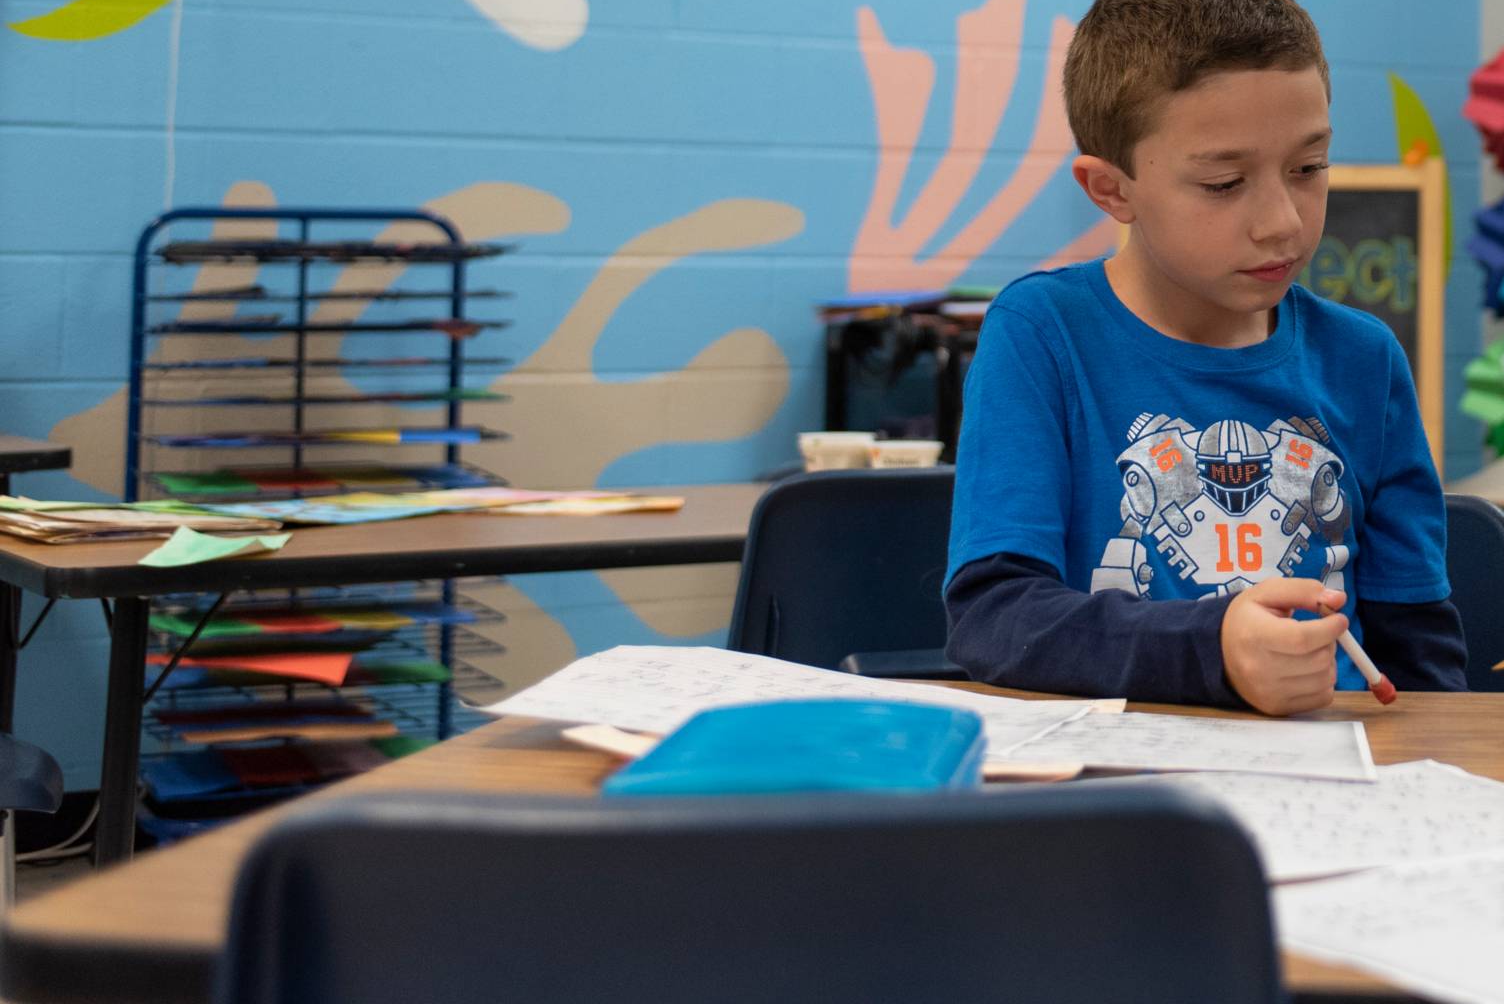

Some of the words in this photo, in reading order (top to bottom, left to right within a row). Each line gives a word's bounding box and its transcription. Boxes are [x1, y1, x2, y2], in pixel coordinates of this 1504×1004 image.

[1149, 437, 1182, 473] 16
[1285, 438, 1314, 470] 16
[1210, 463, 1259, 485] MVP
[1215, 523, 1263, 573] 16
